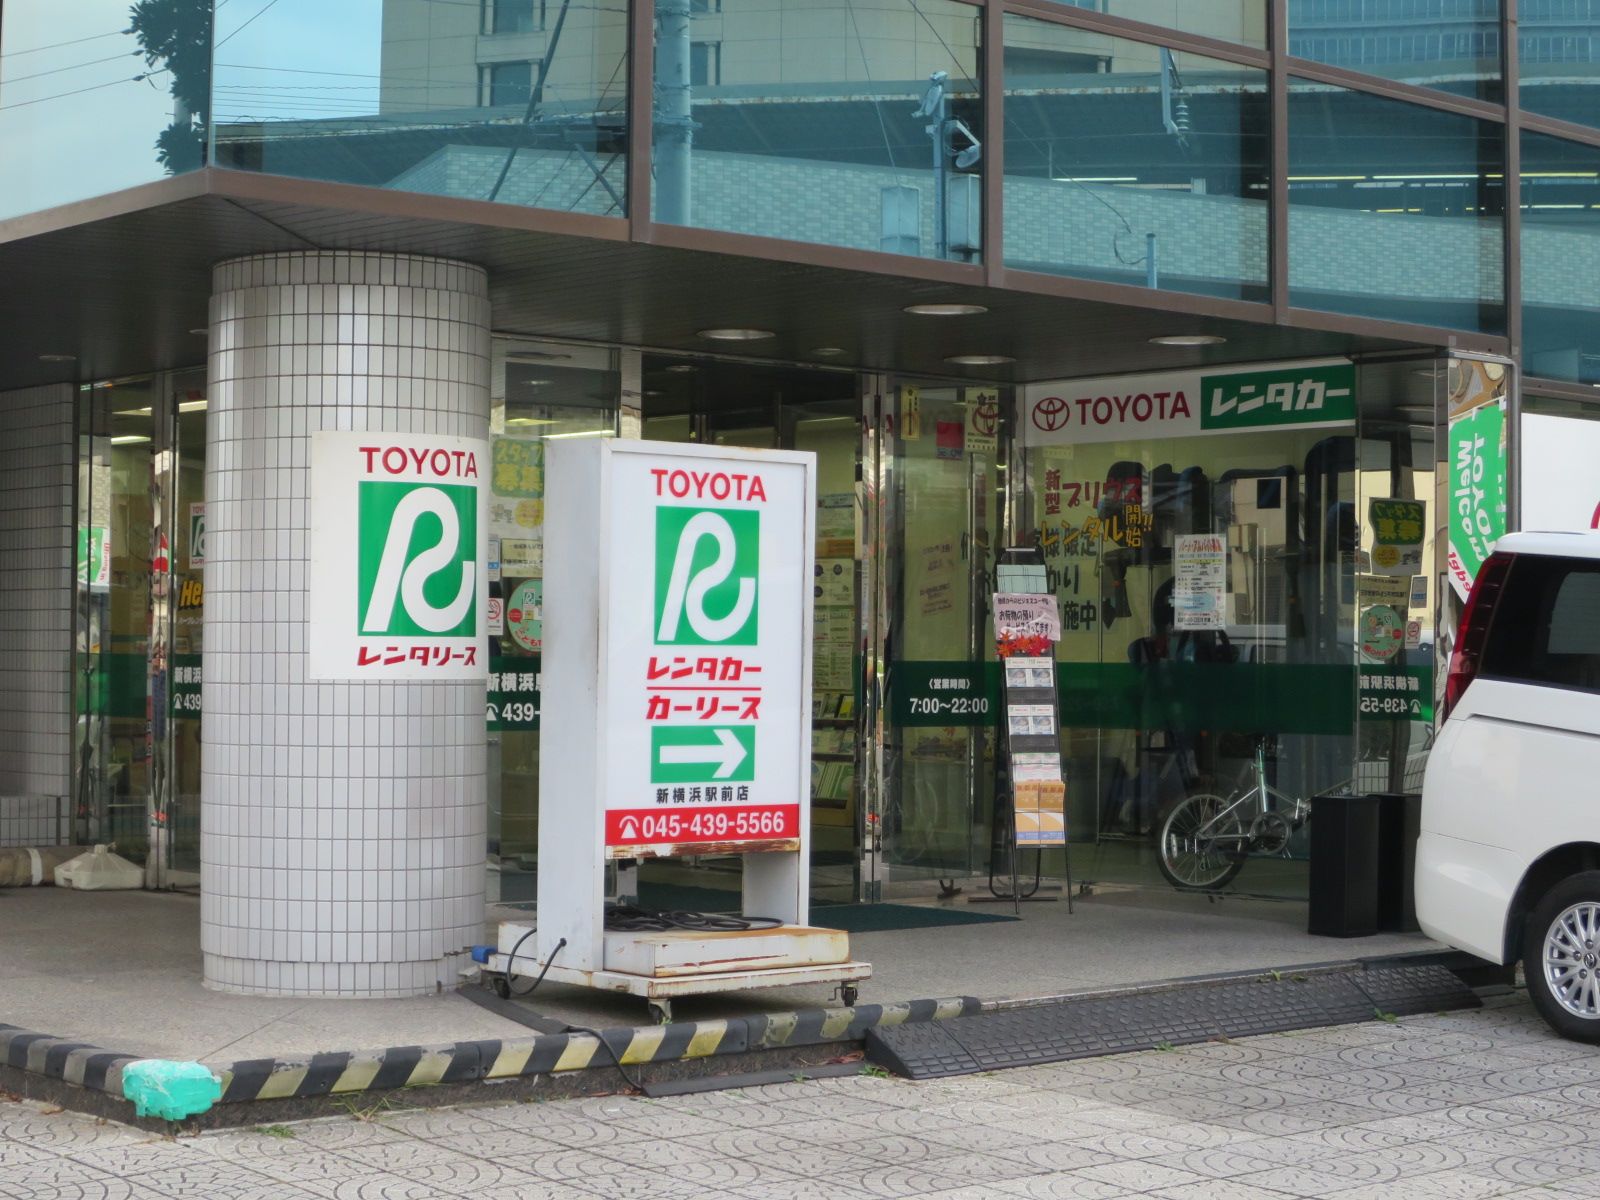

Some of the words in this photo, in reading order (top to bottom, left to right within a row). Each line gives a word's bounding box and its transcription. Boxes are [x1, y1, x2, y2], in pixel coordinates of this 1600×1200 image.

[1076, 391, 1192, 427] TOYOTA
[1210, 378, 1350, 417] レンタカー
[359, 446, 478, 478] TOYOTA
[651, 469, 767, 503] TOYOTA
[1045, 469, 1061, 515] 新型
[1062, 477, 1143, 509] プリウス
[1040, 515, 1123, 546] レンタル
[1126, 504, 1141, 549] 開始
[357, 645, 477, 668] レンタリース
[647, 656, 762, 681] レンタカー
[646, 696, 762, 720] カーリース
[656, 785, 750, 805] 新横浜駅前店
[642, 811, 785, 838] 045-439-5566
